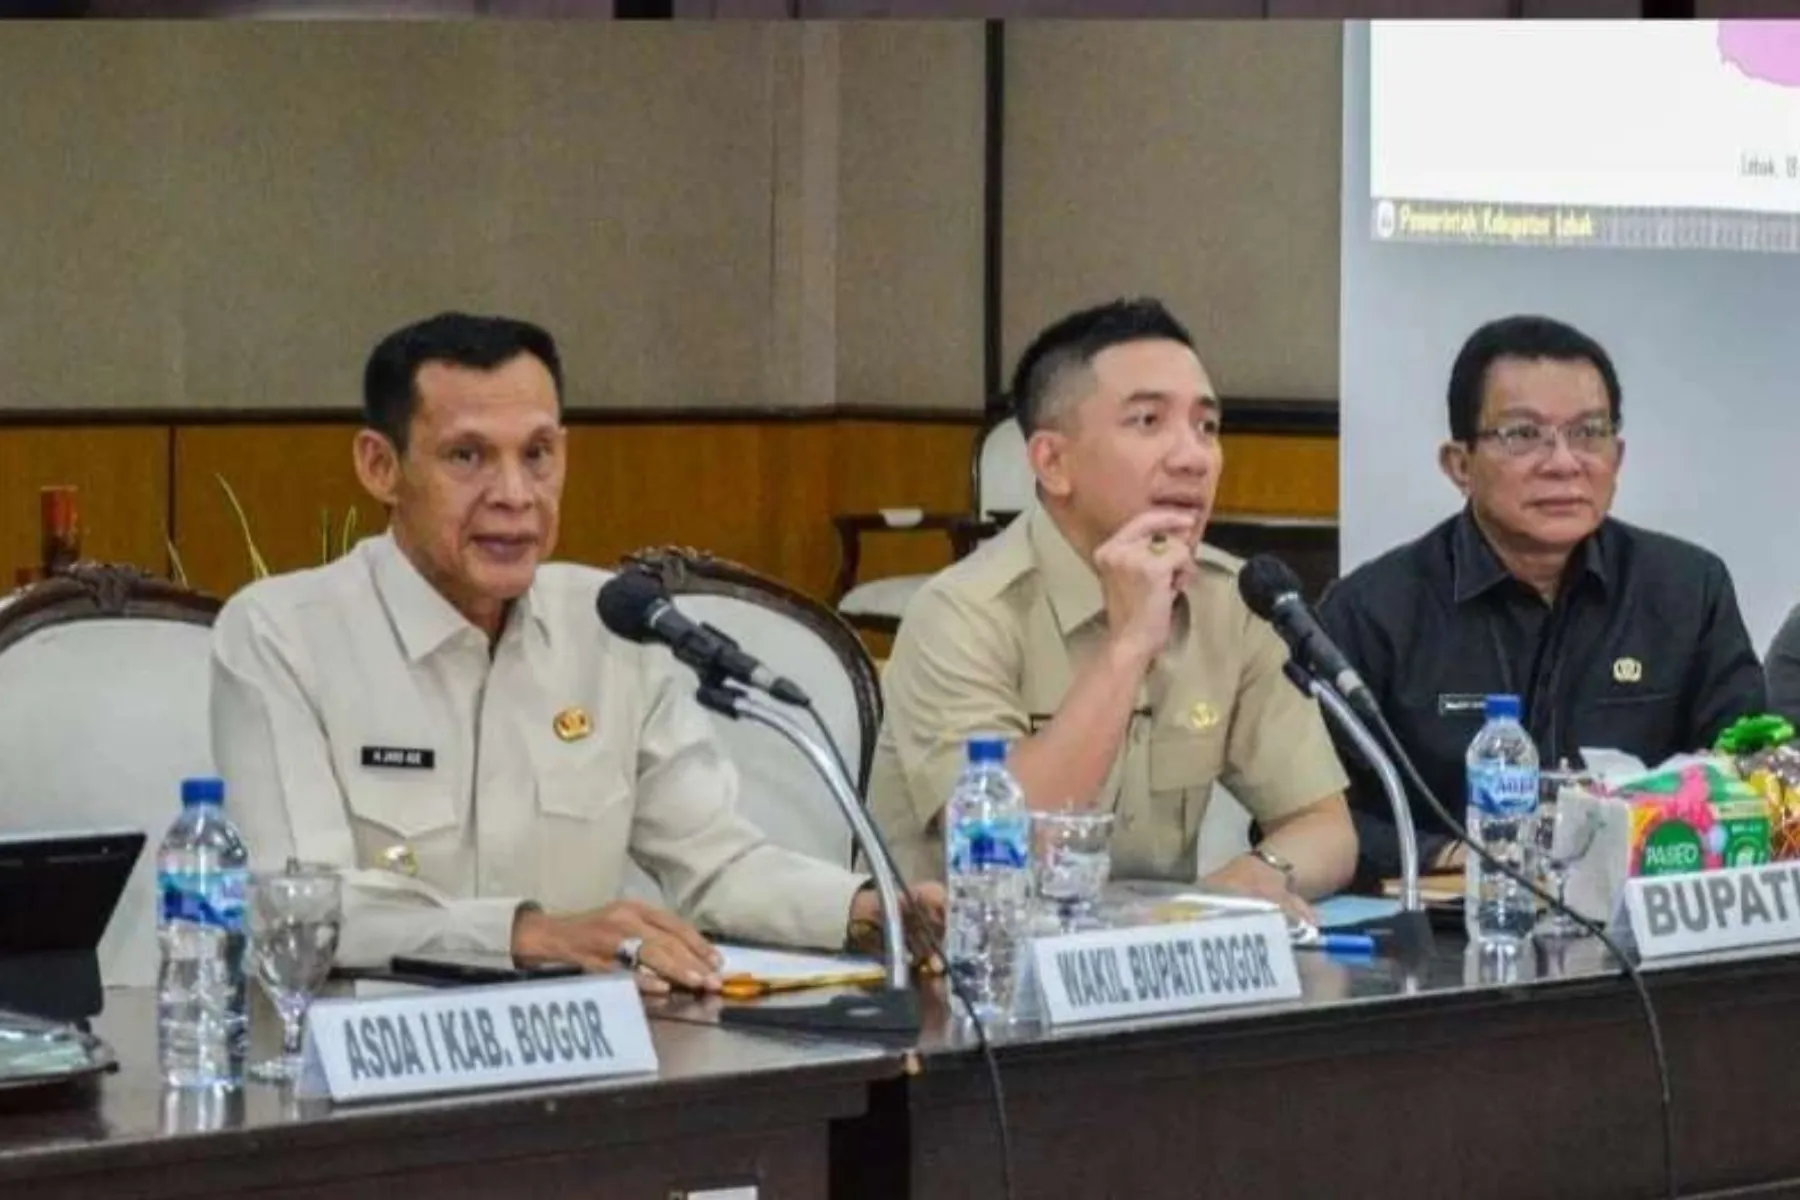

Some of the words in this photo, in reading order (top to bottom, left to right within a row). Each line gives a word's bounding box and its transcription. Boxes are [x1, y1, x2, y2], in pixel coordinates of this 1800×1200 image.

[1056, 947, 1129, 1007] WAKIL
[1127, 940, 1204, 1001] BUPATI
[1202, 933, 1278, 994] BOGOR
[343, 1015, 425, 1080] ASDA
[437, 1008, 514, 1072] KAB.
[509, 1000, 614, 1063] BOGOR
